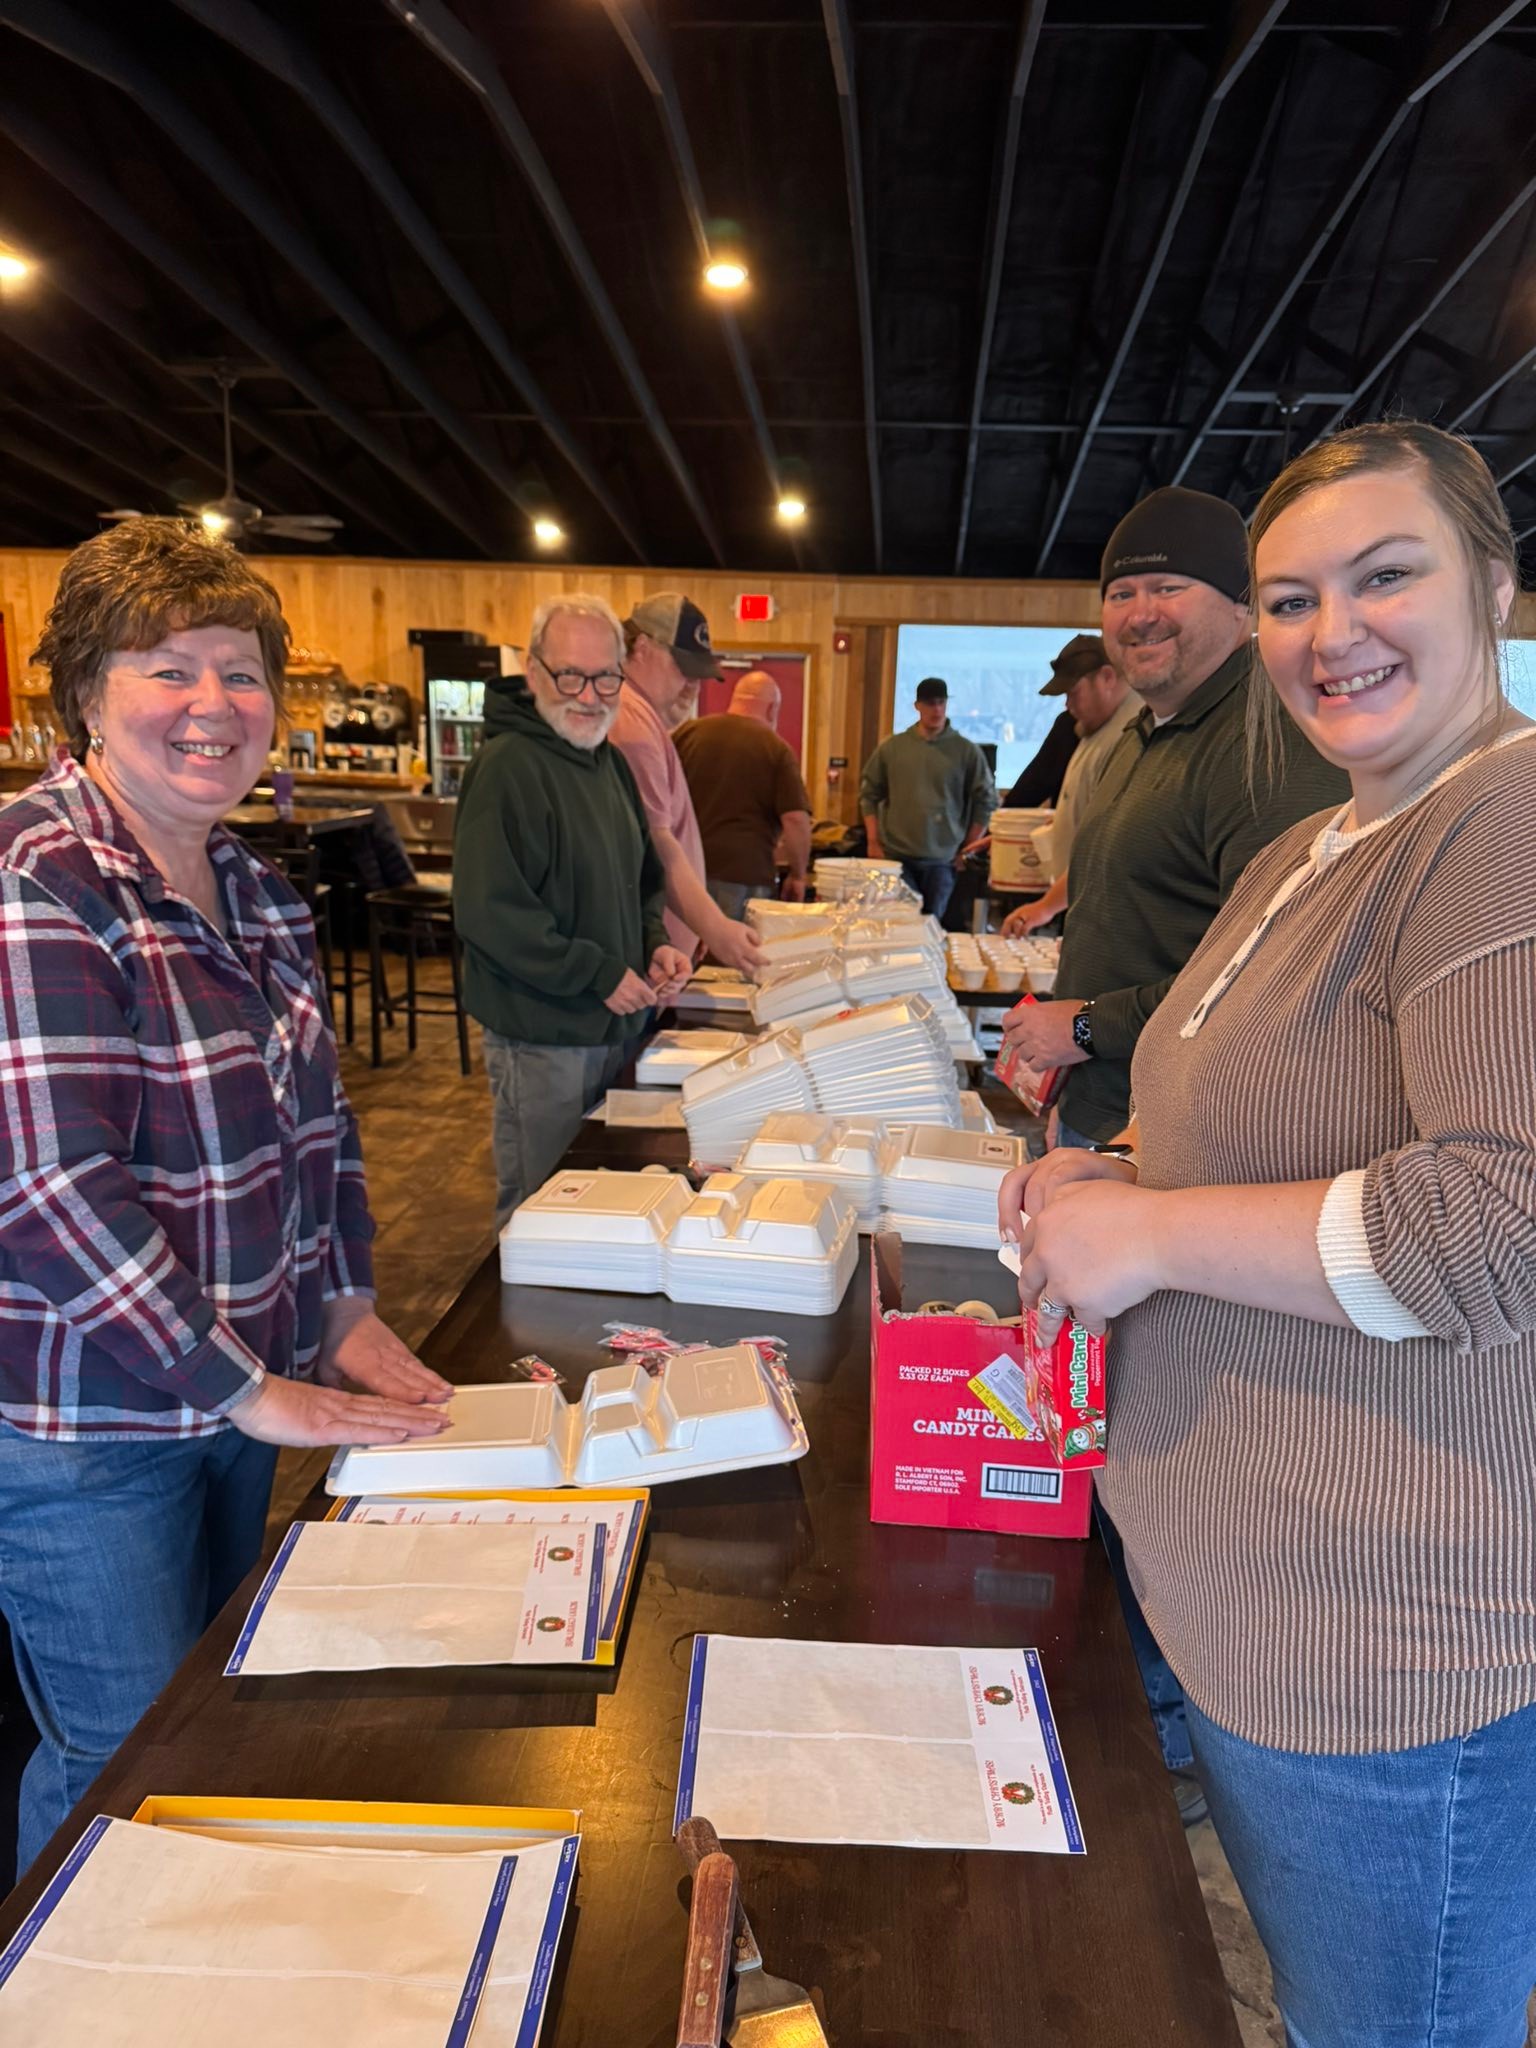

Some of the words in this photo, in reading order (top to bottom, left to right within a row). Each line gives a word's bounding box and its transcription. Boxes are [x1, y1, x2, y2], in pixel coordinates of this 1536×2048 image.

[1121, 552, 1168, 565] Columbia
[899, 1365, 931, 1374] PACKED
[933, 1367, 941, 1375] 12
[942, 1368, 970, 1377] BOXES
[930, 1375, 953, 1383] EACH
[1070, 1373, 1088, 1408] Mini
[956, 1407, 1003, 1424] MIN
[913, 1419, 979, 1437] CANDY
[982, 1424, 1046, 1442] CAES
[922, 1467, 950, 1475] VIETNAM
[950, 1468, 964, 1476] FOR
[895, 1478, 928, 1486] STAMFORD
